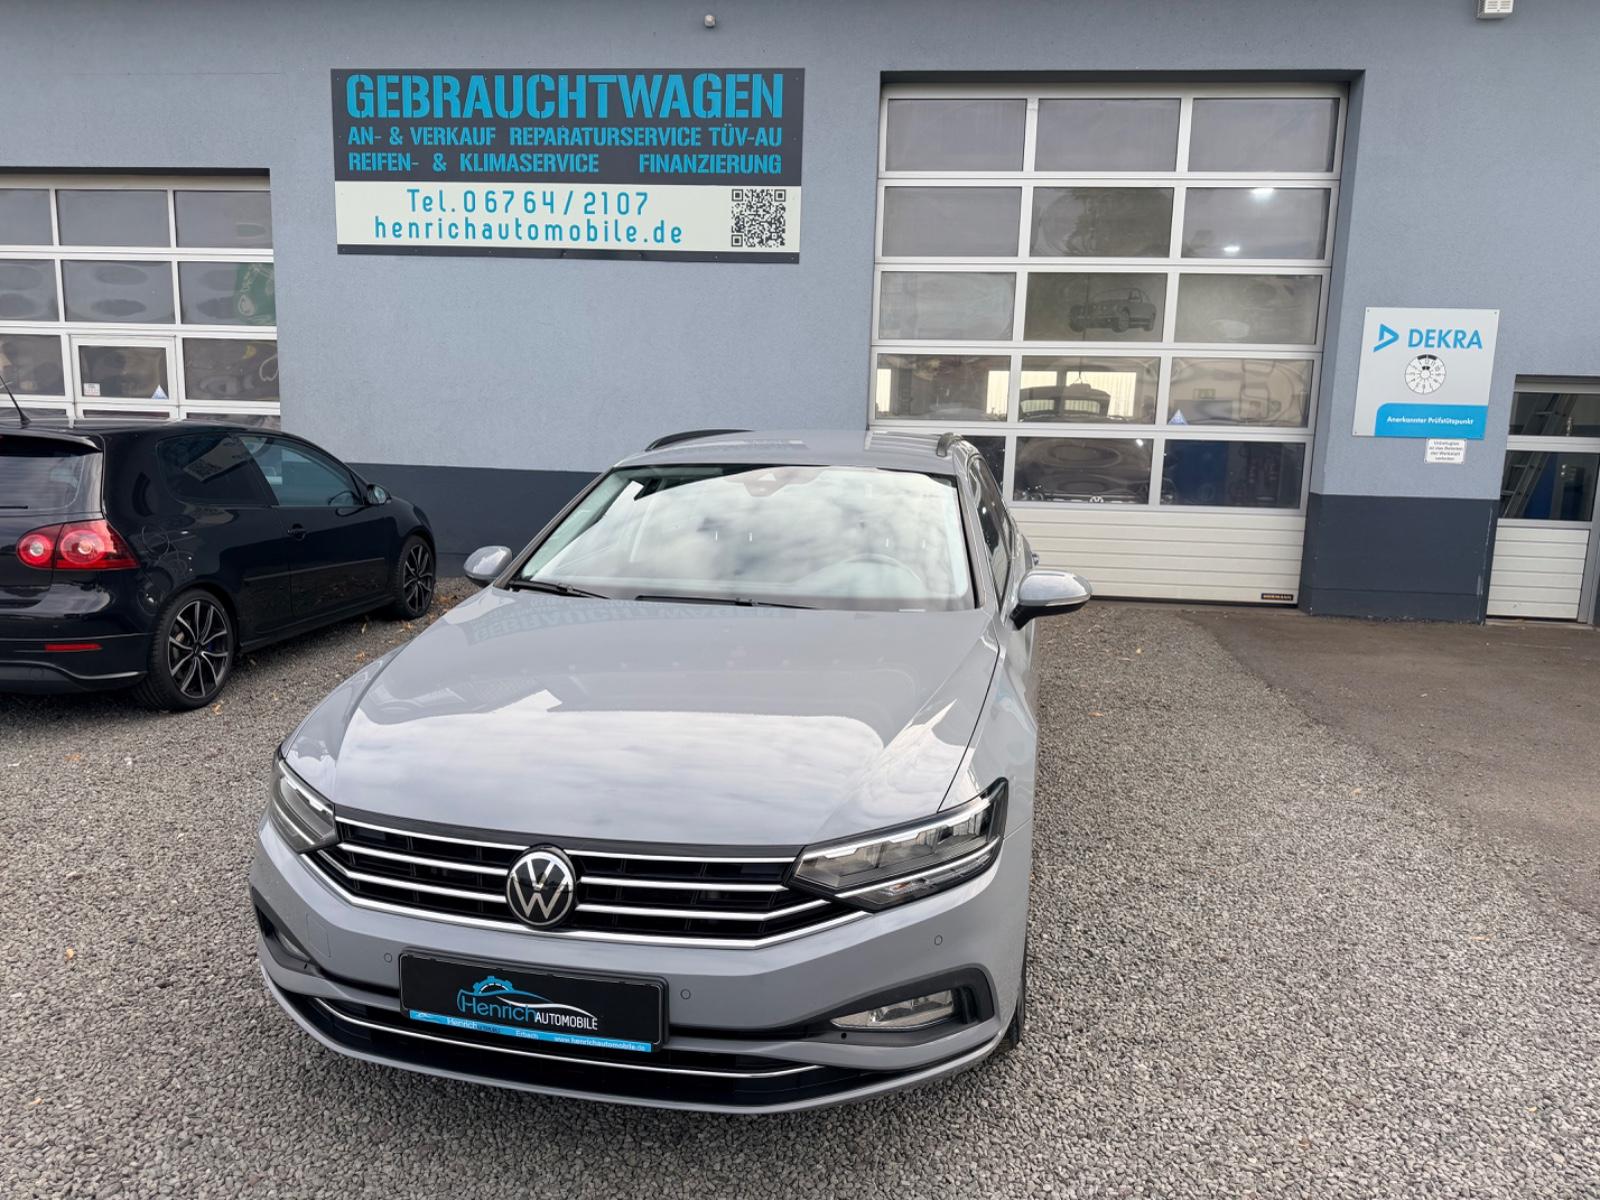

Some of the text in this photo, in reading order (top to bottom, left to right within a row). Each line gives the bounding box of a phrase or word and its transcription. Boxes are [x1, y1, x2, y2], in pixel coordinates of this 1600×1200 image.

[346, 73, 784, 119] GEBRAUCHTWAGEN
[348, 123, 783, 147] AN- & VERKAUF REPARATURSERVICE TÜV-AU
[348, 151, 783, 174] REIFEN- & KLIMASERVICE FINANZIERUNG
[374, 215, 683, 244] henrichautomobile.de
[1407, 328, 1483, 349] DEKRA
